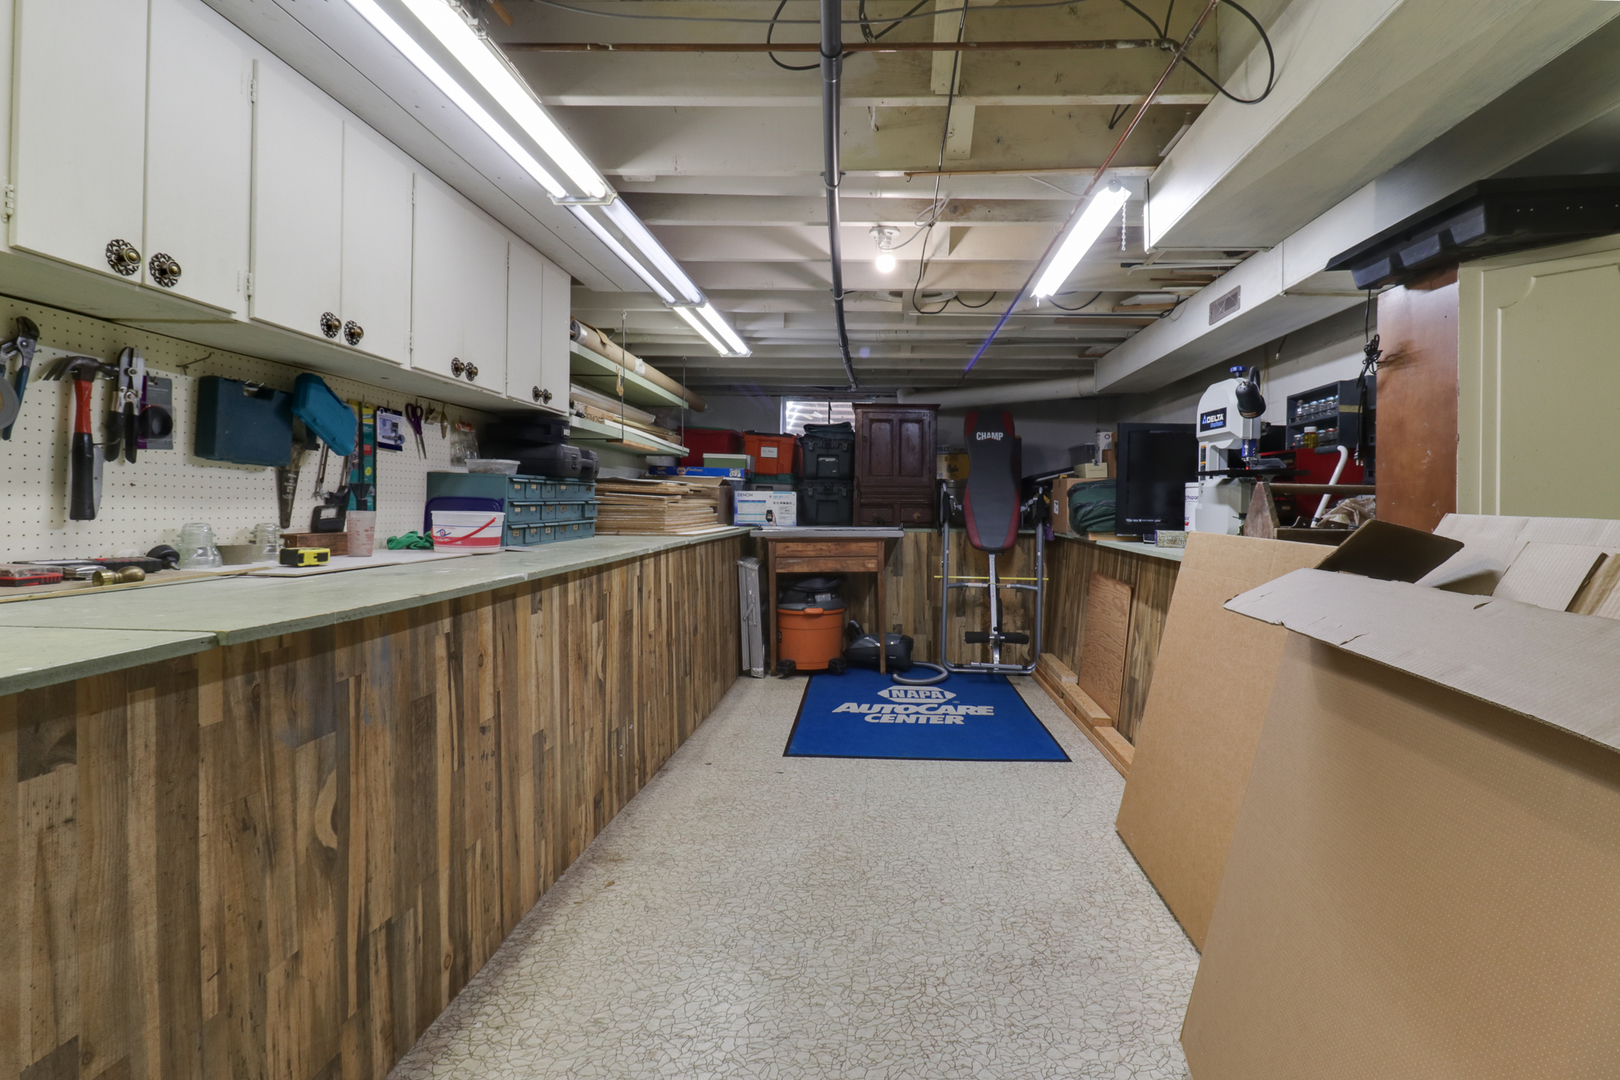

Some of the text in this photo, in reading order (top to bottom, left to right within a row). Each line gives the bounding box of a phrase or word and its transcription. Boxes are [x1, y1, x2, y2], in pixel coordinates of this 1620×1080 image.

[1207, 414, 1224, 423] DELTA
[976, 431, 1004, 441] CHAMP
[892, 689, 943, 699] NAPA
[831, 702, 995, 716] AUTOCARE
[864, 713, 965, 725] CENTER
